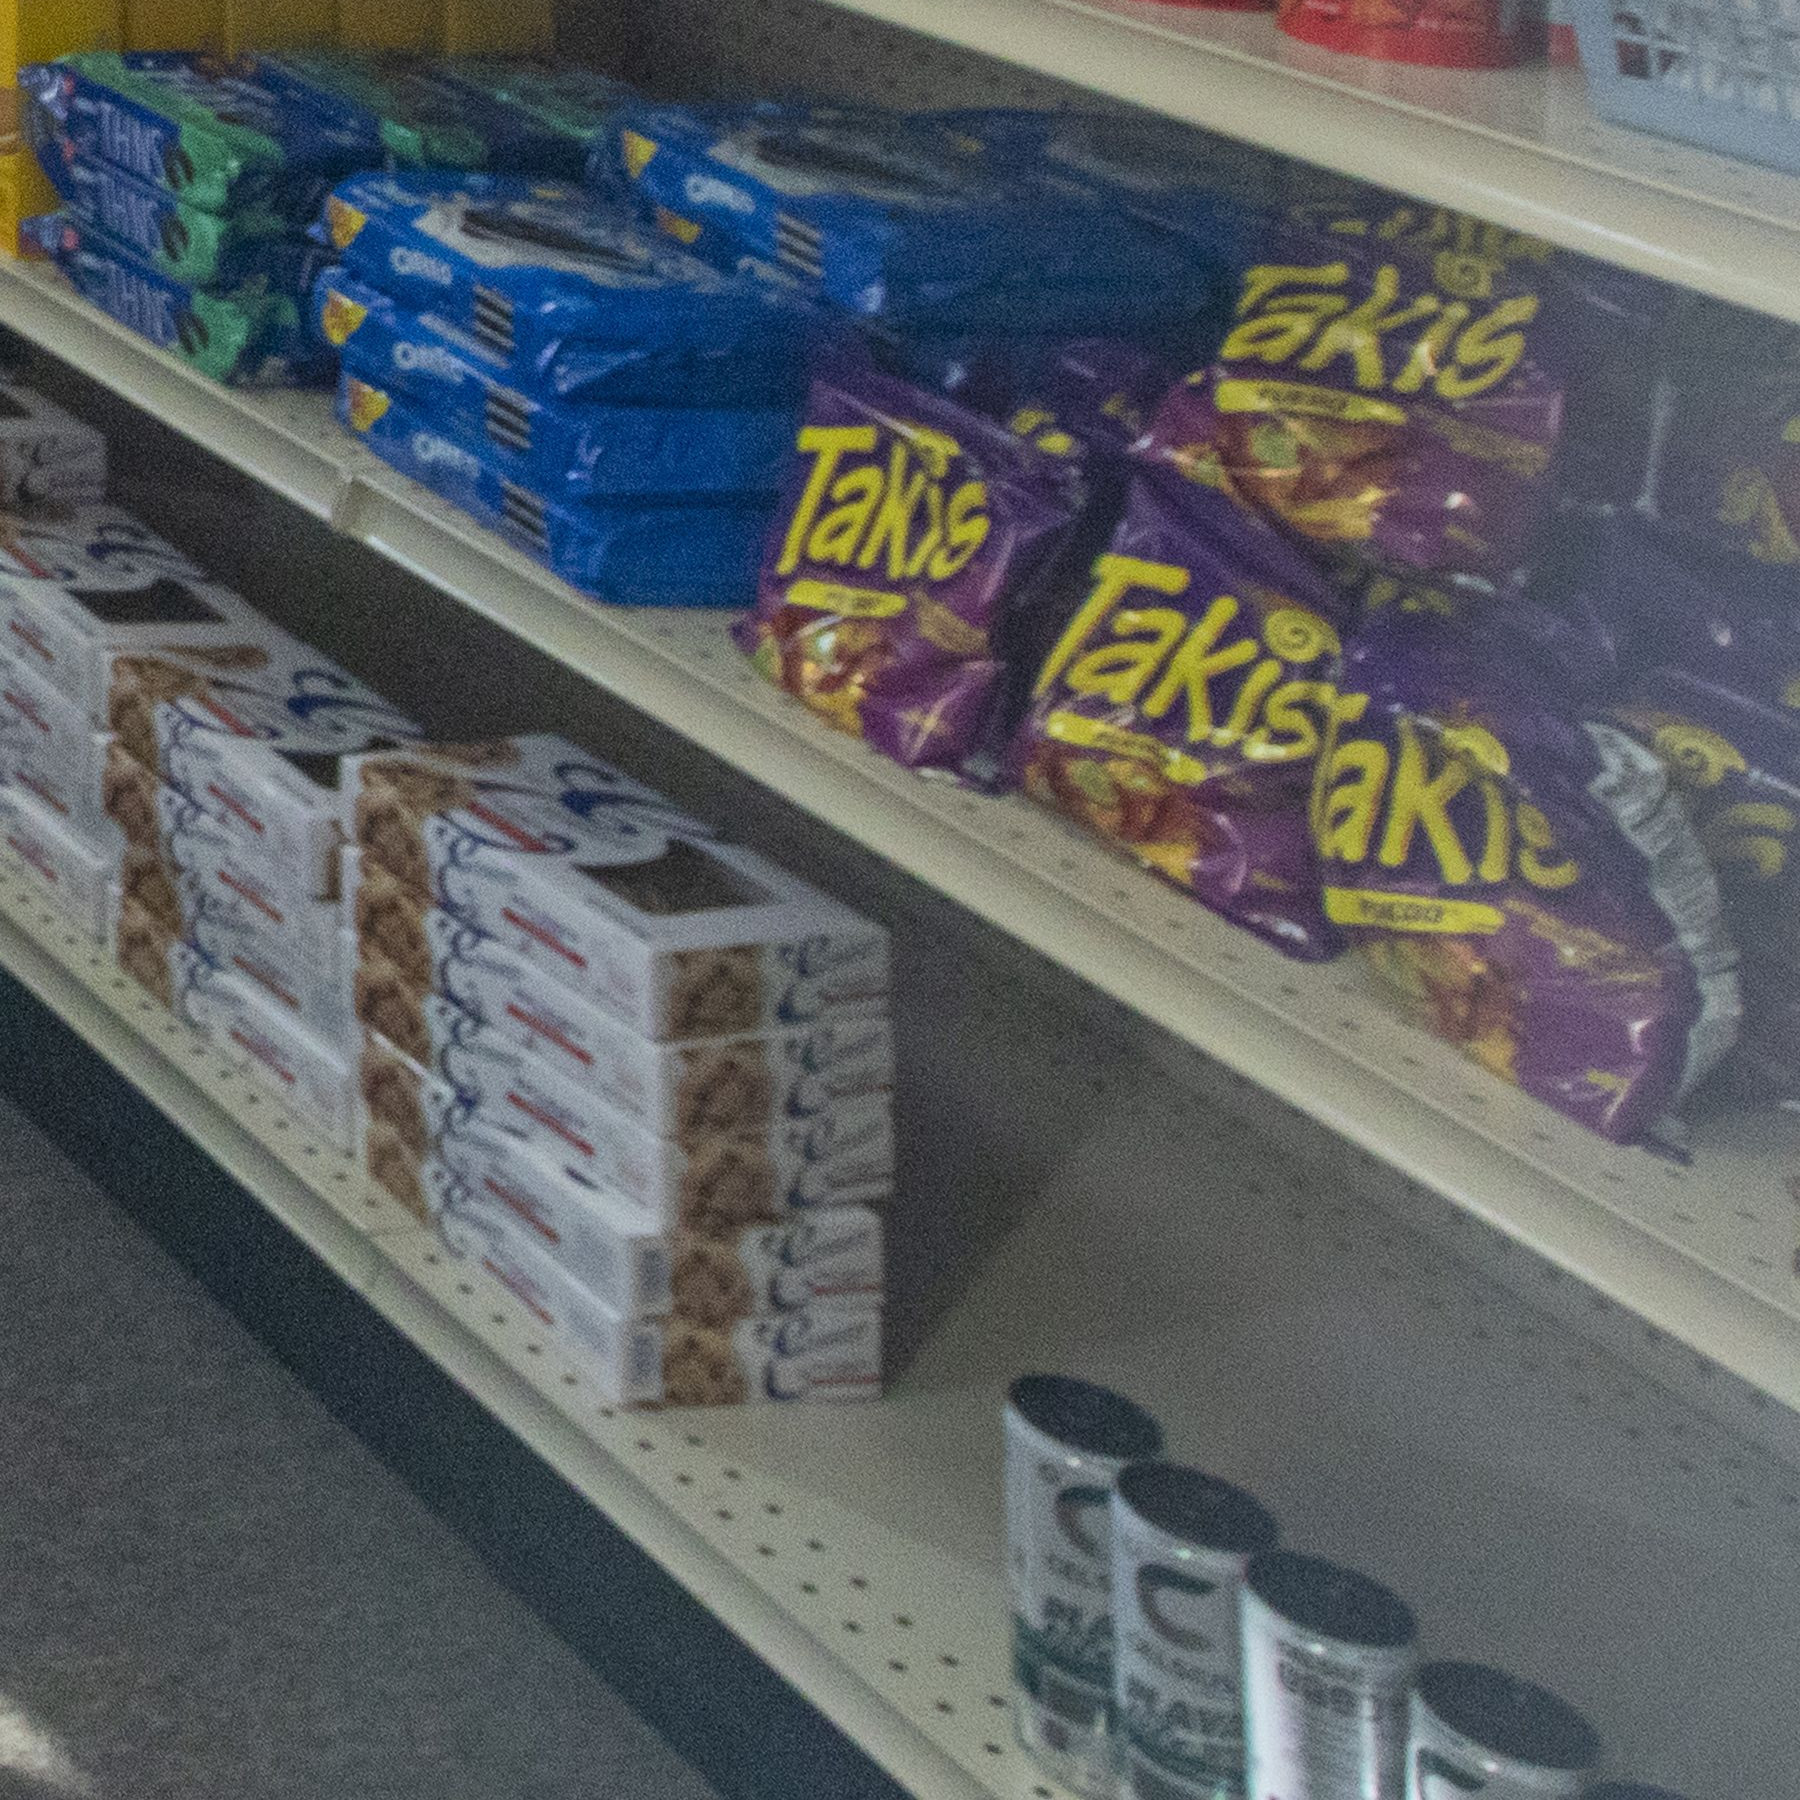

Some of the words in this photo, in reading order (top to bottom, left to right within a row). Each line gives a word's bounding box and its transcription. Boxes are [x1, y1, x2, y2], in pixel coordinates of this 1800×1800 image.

[1219, 265, 1539, 399] Takis
[778, 424, 989, 580] Takis
[1035, 556, 1324, 763] Takis
